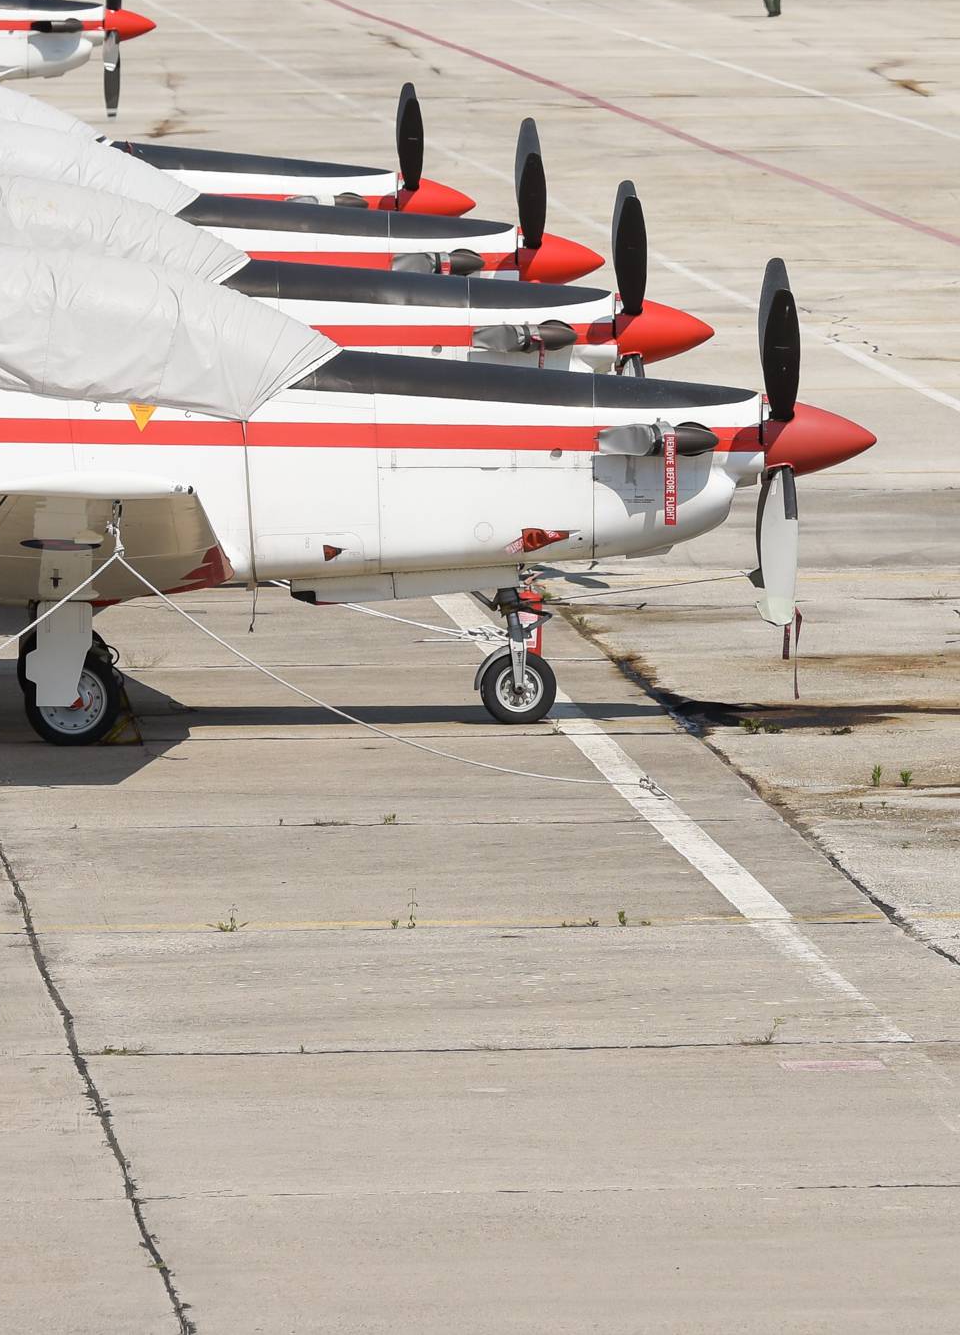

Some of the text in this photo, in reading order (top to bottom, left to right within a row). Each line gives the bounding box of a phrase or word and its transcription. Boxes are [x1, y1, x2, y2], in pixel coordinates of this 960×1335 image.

[666, 436, 675, 521] REMOVE BEFORE FLIGHT
